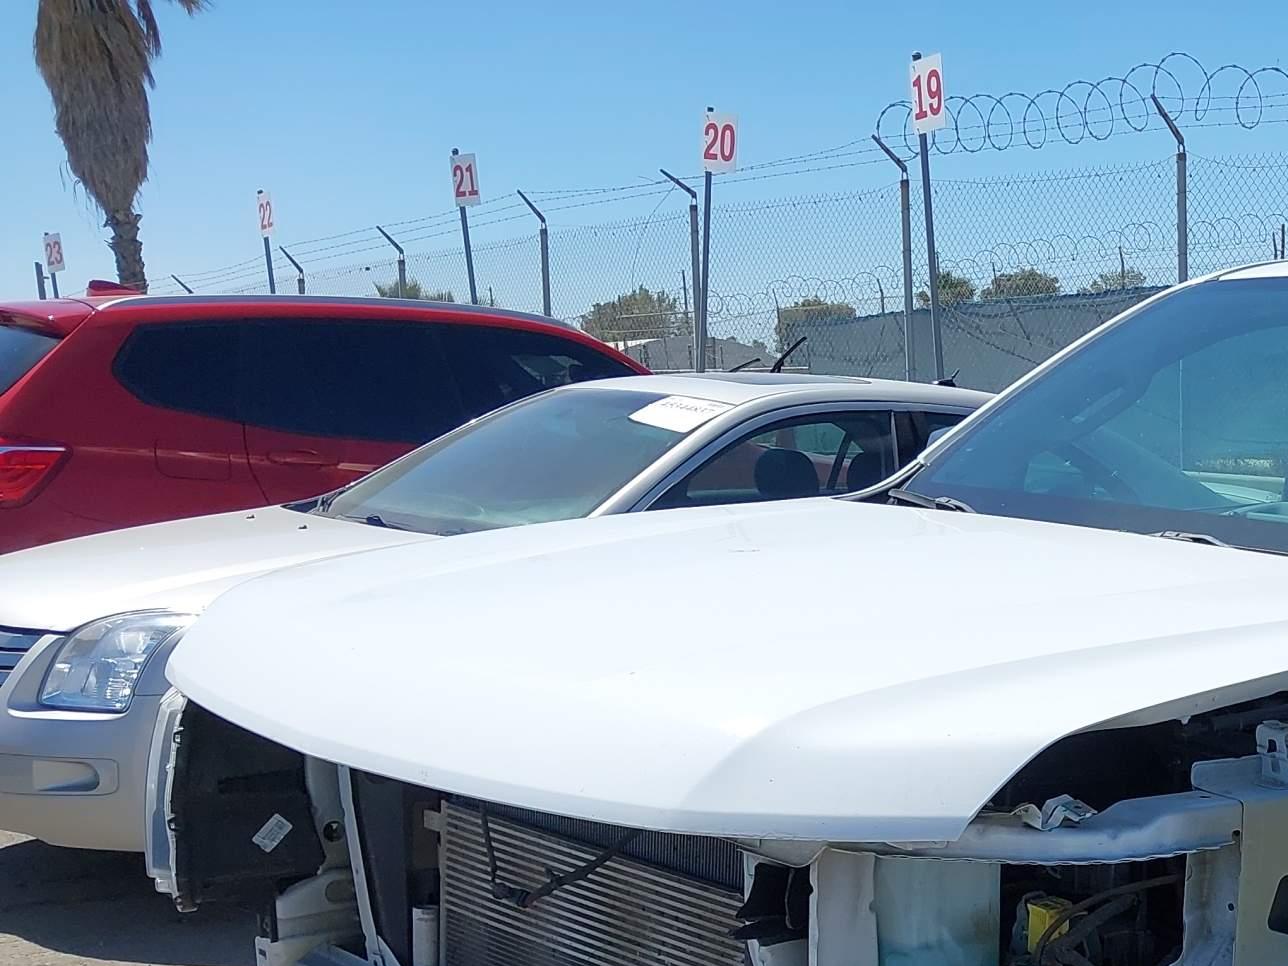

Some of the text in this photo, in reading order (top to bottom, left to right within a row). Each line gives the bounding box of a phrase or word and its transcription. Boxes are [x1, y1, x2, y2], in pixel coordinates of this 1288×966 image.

[912, 69, 942, 121] 19
[704, 122, 736, 162] 20
[453, 163, 479, 198] 21
[259, 200, 273, 230] 22
[45, 241, 64, 266] 23
